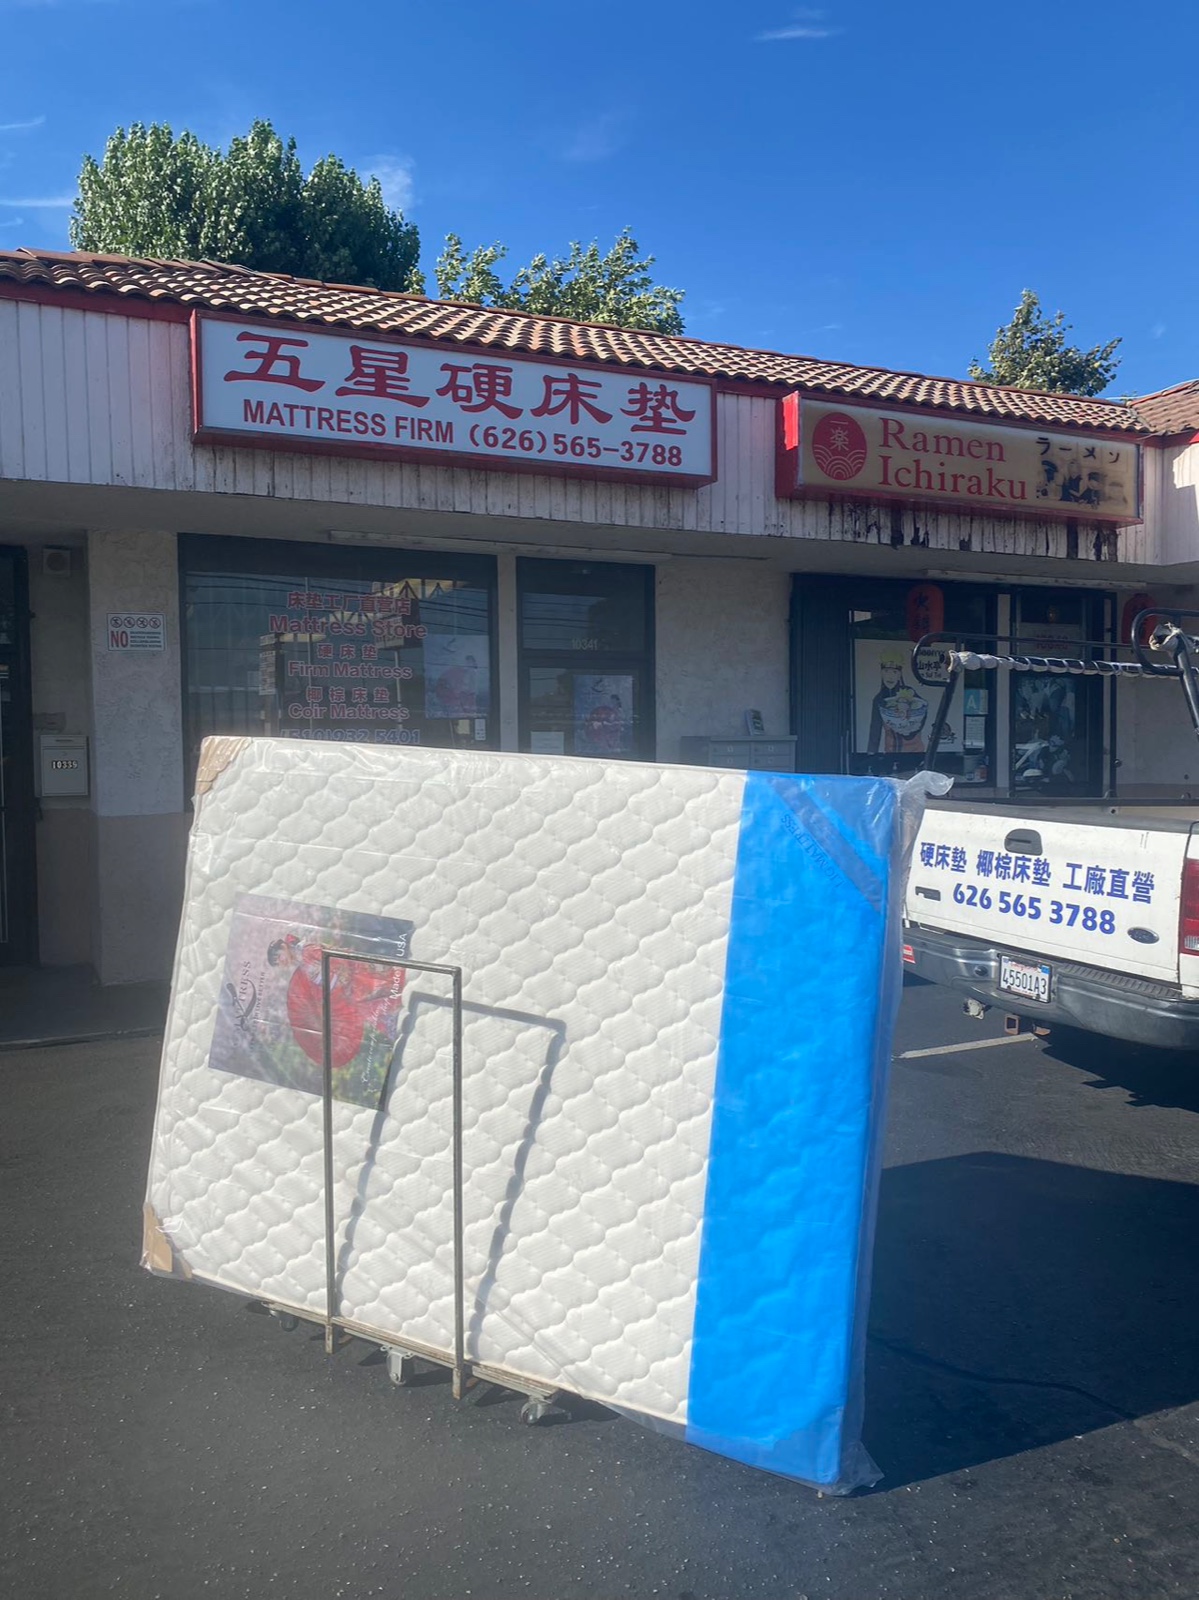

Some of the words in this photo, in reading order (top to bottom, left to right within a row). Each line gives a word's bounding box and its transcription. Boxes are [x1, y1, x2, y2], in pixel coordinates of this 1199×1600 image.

[224, 331, 697, 436] 五星硬床垫
[243, 399, 386, 437] MATTRESS
[395, 415, 454, 444] FIRM
[878, 417, 1006, 463] Ramen
[878, 455, 1028, 501] Ichiraku
[287, 591, 411, 615] 床垫工厂直营店
[110, 630, 129, 648] NO
[269, 615, 366, 636] Mattress
[372, 619, 428, 638] Store
[317, 644, 378, 660] 硬床垫
[288, 661, 330, 677] Firm
[333, 663, 413, 679] Mattress
[306, 686, 390, 703] 椰棕床垫
[966, 695, 976, 709] A
[288, 703, 327, 719] Coir
[330, 704, 410, 720] Mattress
[920, 841, 967, 874] 硬床墊
[976, 849, 1051, 888] 椰棕床墊
[1062, 862, 1155, 905] 工廠直營
[953, 883, 992, 910] 626
[998, 891, 1041, 920] 565
[1049, 900, 1116, 935] 3788
[389, 967, 402, 1000] Made
[396, 933, 408, 957] USA
[1003, 968, 1046, 995] 45501A3
